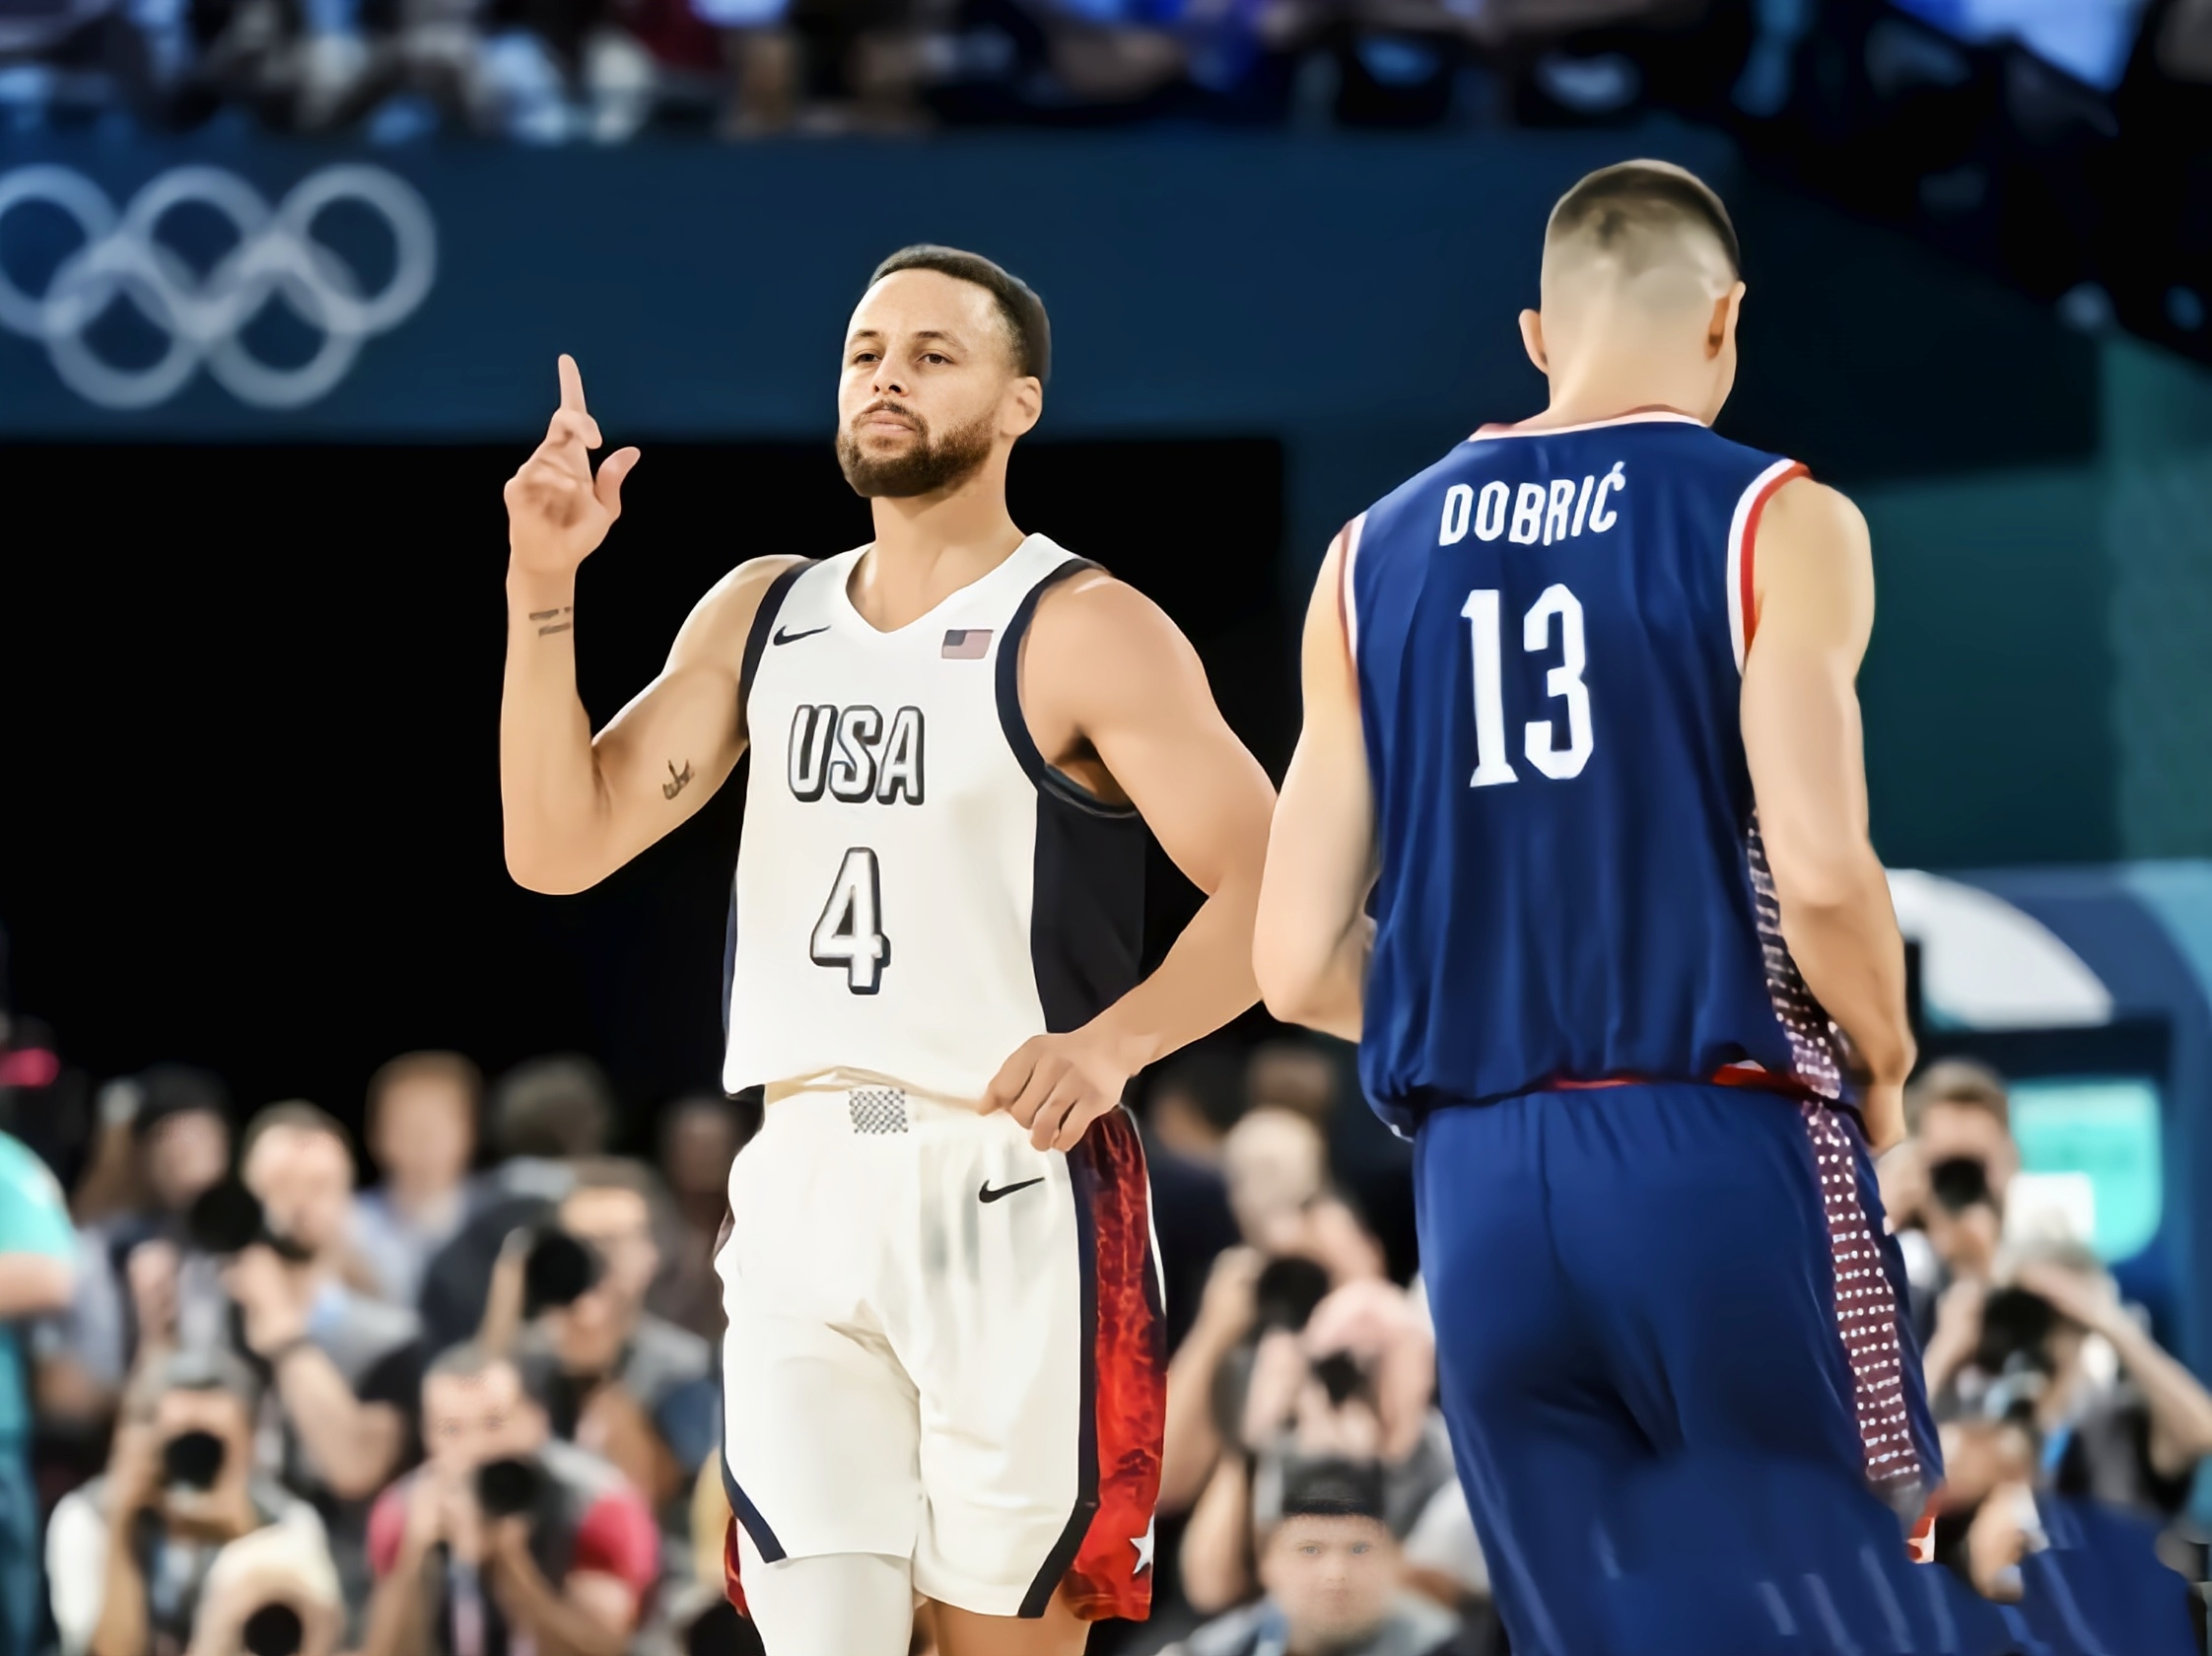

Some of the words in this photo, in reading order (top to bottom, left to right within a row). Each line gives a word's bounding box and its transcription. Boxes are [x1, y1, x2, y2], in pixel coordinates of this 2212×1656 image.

[1439, 461, 1625, 546] DOBRIĆ
[1461, 584, 1593, 788] 13
[788, 705, 926, 806] USA
[810, 847, 891, 995] 4
